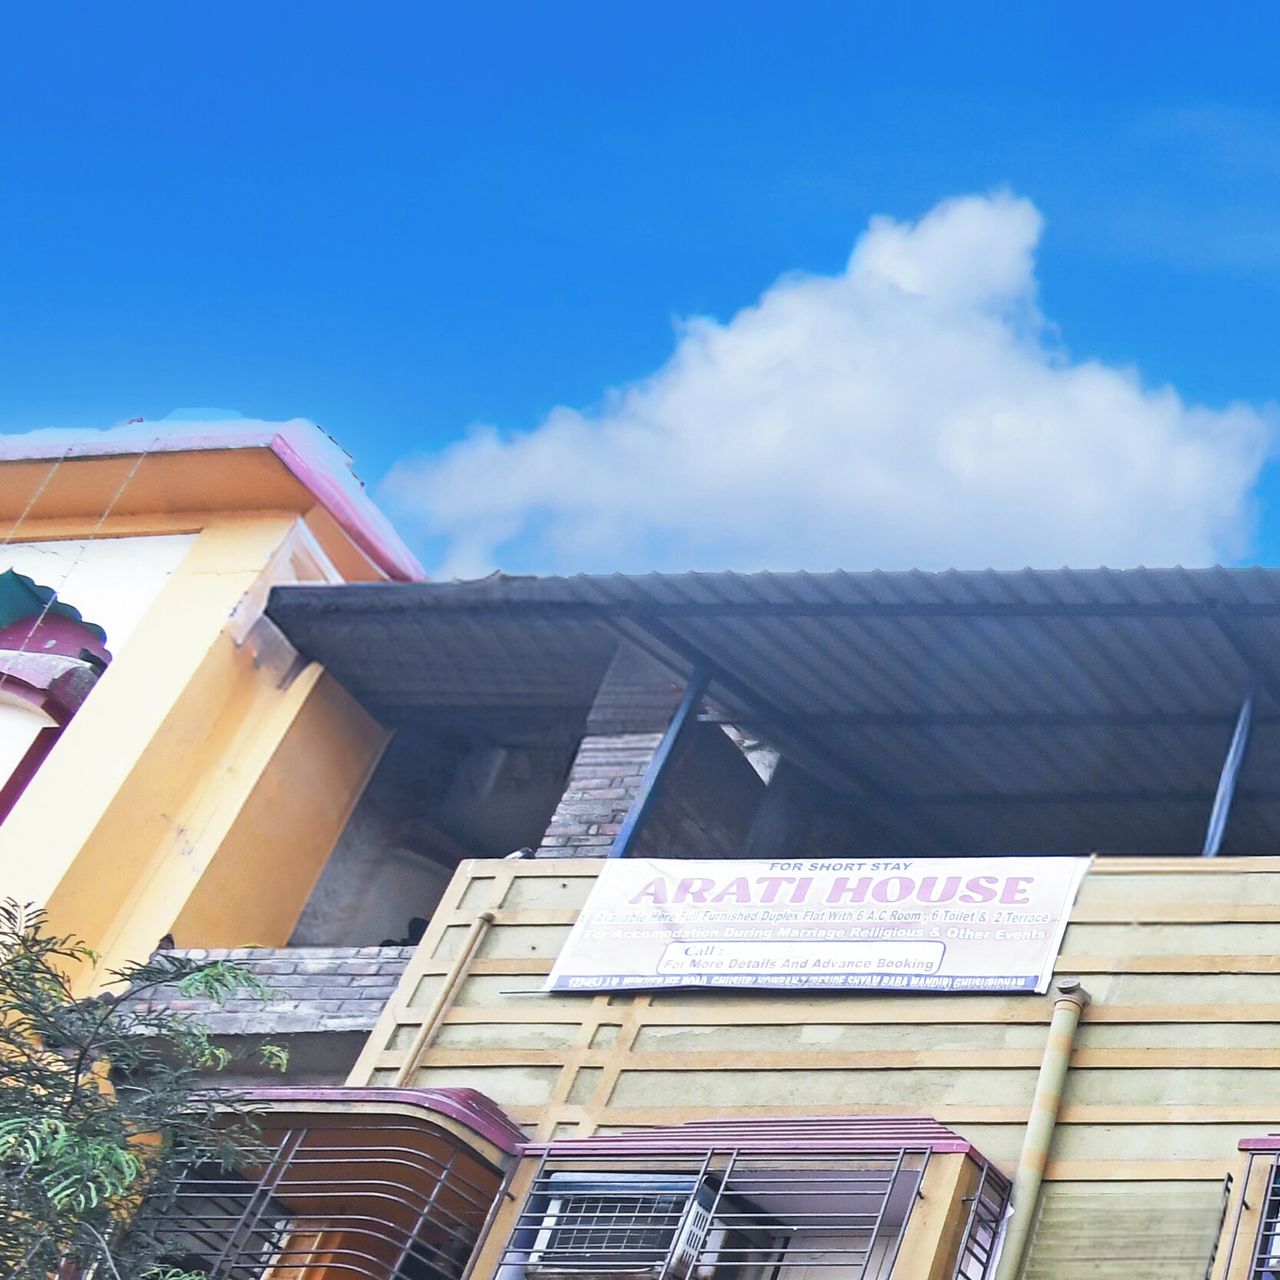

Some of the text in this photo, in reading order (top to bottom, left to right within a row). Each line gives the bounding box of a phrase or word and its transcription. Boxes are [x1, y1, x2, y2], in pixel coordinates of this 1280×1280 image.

[769, 862, 913, 871] FOR SHORT STAY
[628, 876, 1034, 904] ARATI HOUSE
[702, 910, 758, 921] Furnished
[760, 910, 799, 924] Duplex
[802, 910, 826, 921] Flat
[828, 910, 854, 921] With
[856, 910, 865, 921] 6
[867, 910, 888, 921] A.C
[931, 910, 940, 921] 6
[943, 910, 975, 921] Toilet
[977, 911, 987, 922] &
[993, 911, 1003, 922] 2
[1006, 911, 1049, 923] Terrace
[723, 927, 773, 940] During
[777, 926, 846, 938] Marriage
[930, 927, 941, 938] &
[947, 927, 992, 940] Other
[995, 928, 1047, 940] Events
[663, 958, 934, 972] For More Details And Advance Booking
